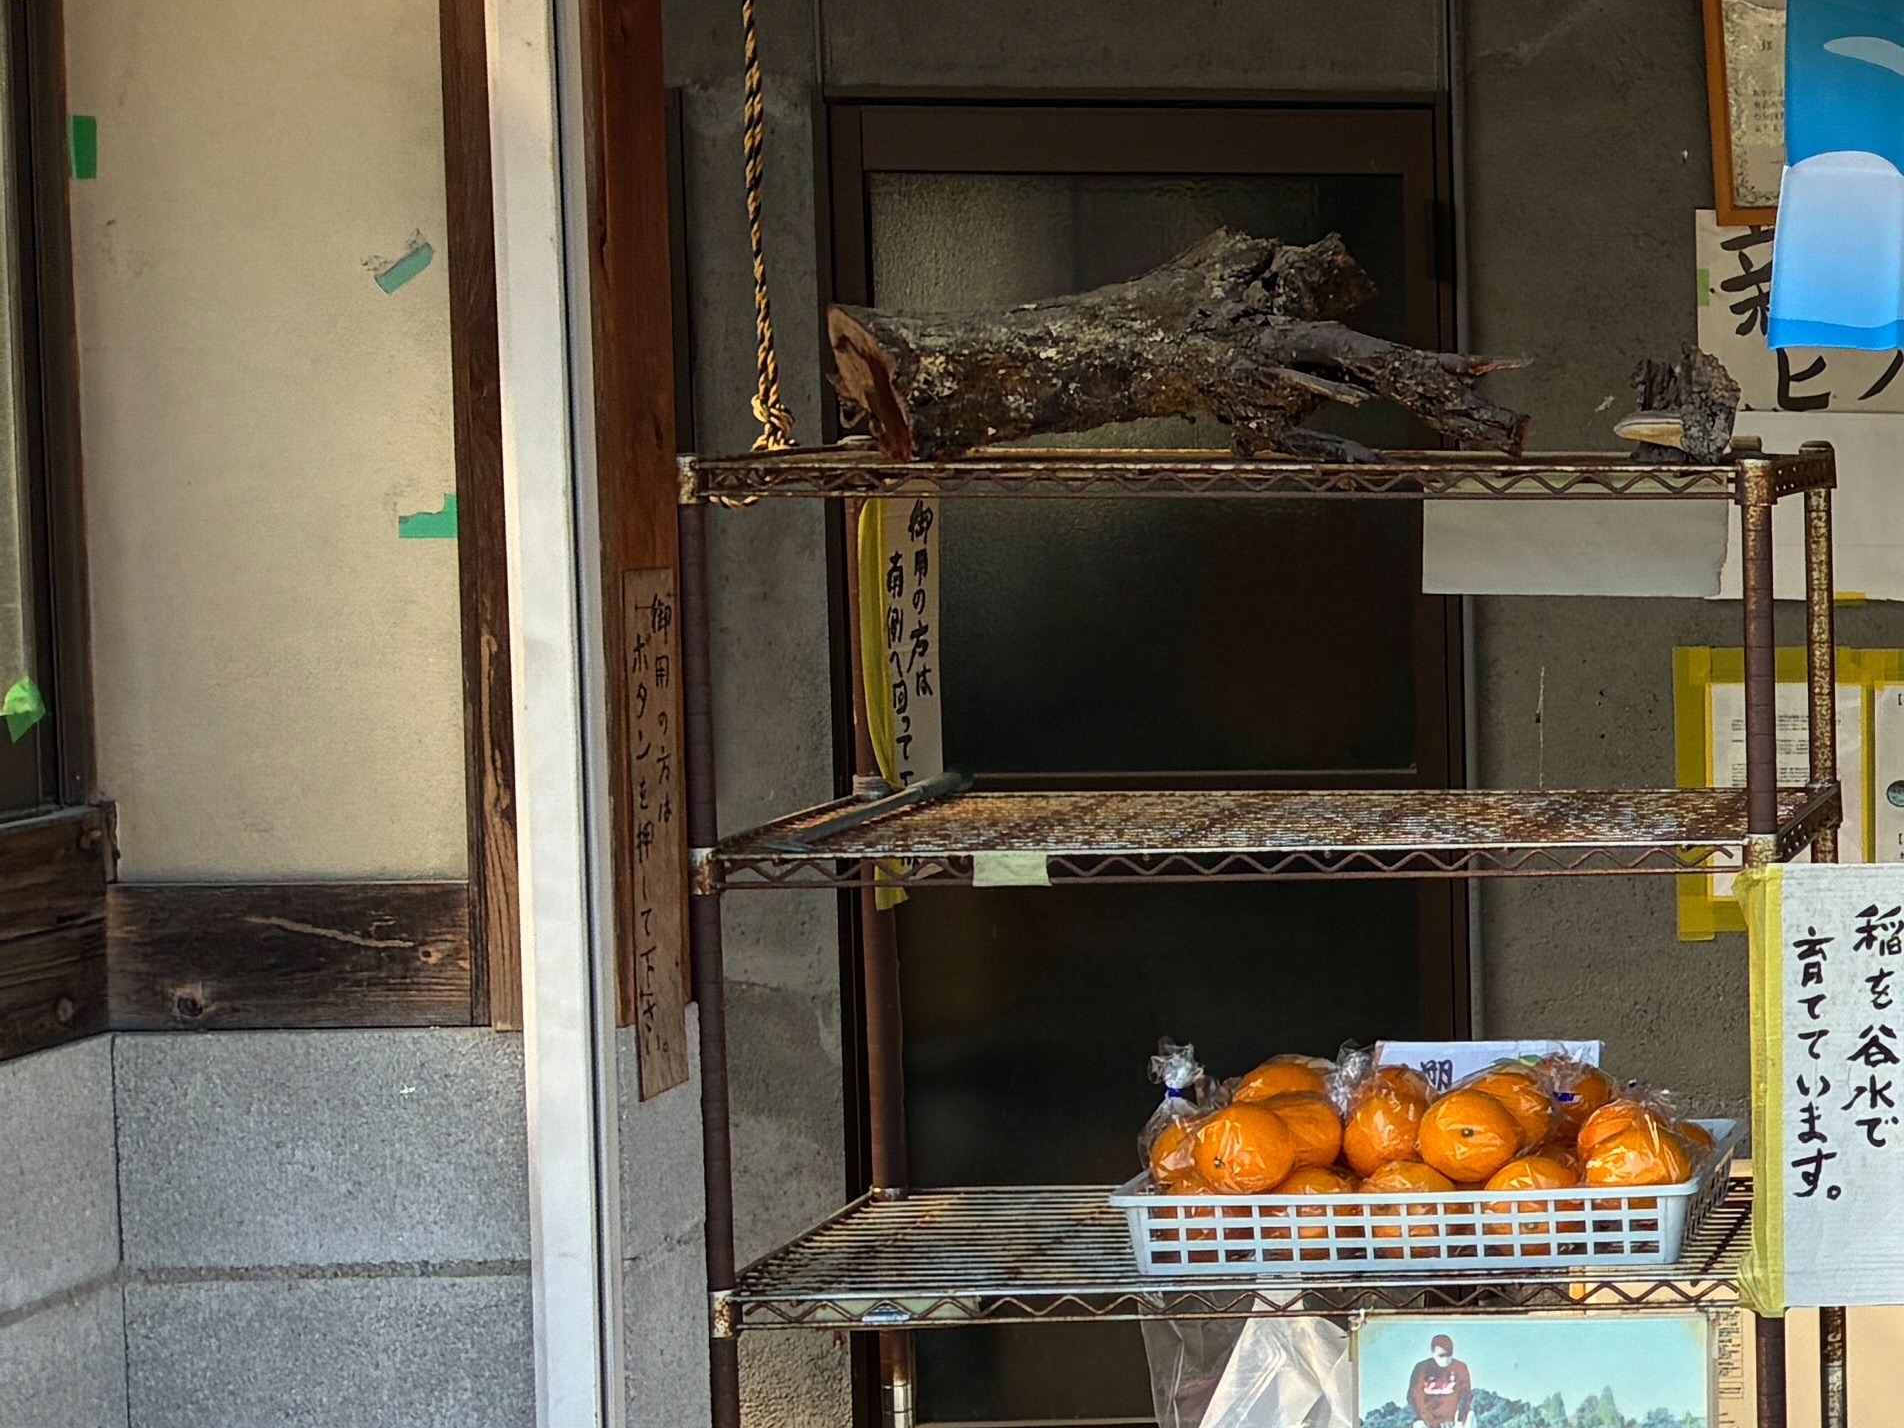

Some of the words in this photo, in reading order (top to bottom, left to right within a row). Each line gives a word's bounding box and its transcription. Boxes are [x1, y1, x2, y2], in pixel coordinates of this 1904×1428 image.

[1791, 925, 1843, 1203] 育てています。
